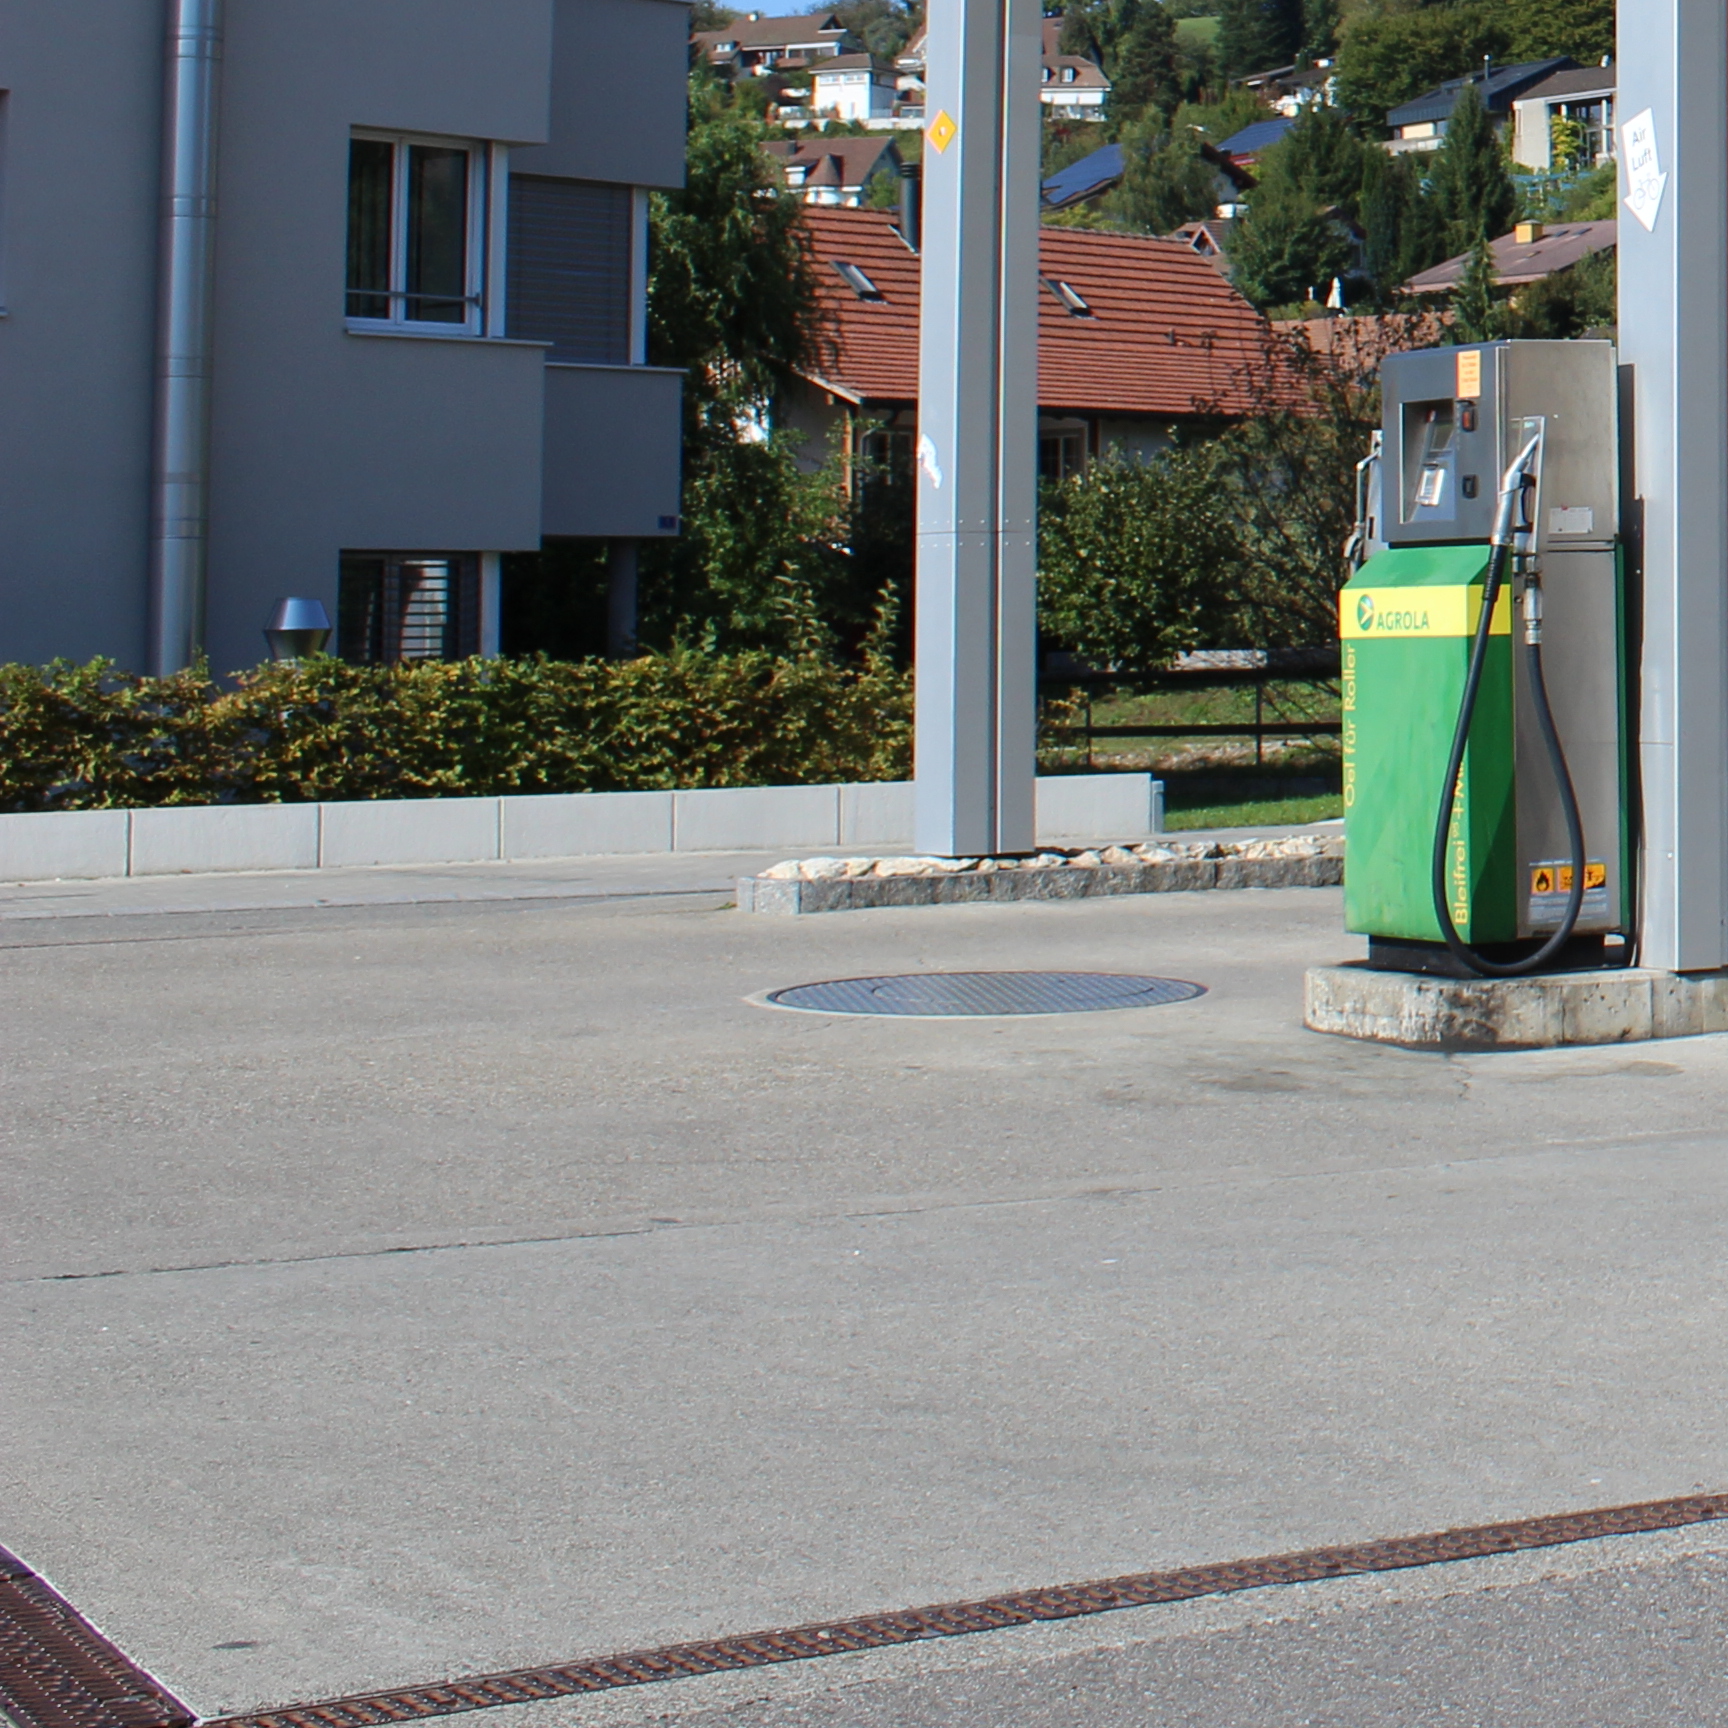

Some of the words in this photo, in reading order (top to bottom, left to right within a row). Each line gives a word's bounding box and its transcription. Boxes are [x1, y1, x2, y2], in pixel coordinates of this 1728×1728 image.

[1631, 127, 1647, 147] Air
[1631, 147, 1652, 172] Luft
[1376, 610, 1430, 631] AGROLA
[1342, 643, 1357, 712] Roller
[1342, 718, 1356, 755] für
[1342, 763, 1356, 808] Oel
[1453, 839, 1468, 925] Bleifrei
